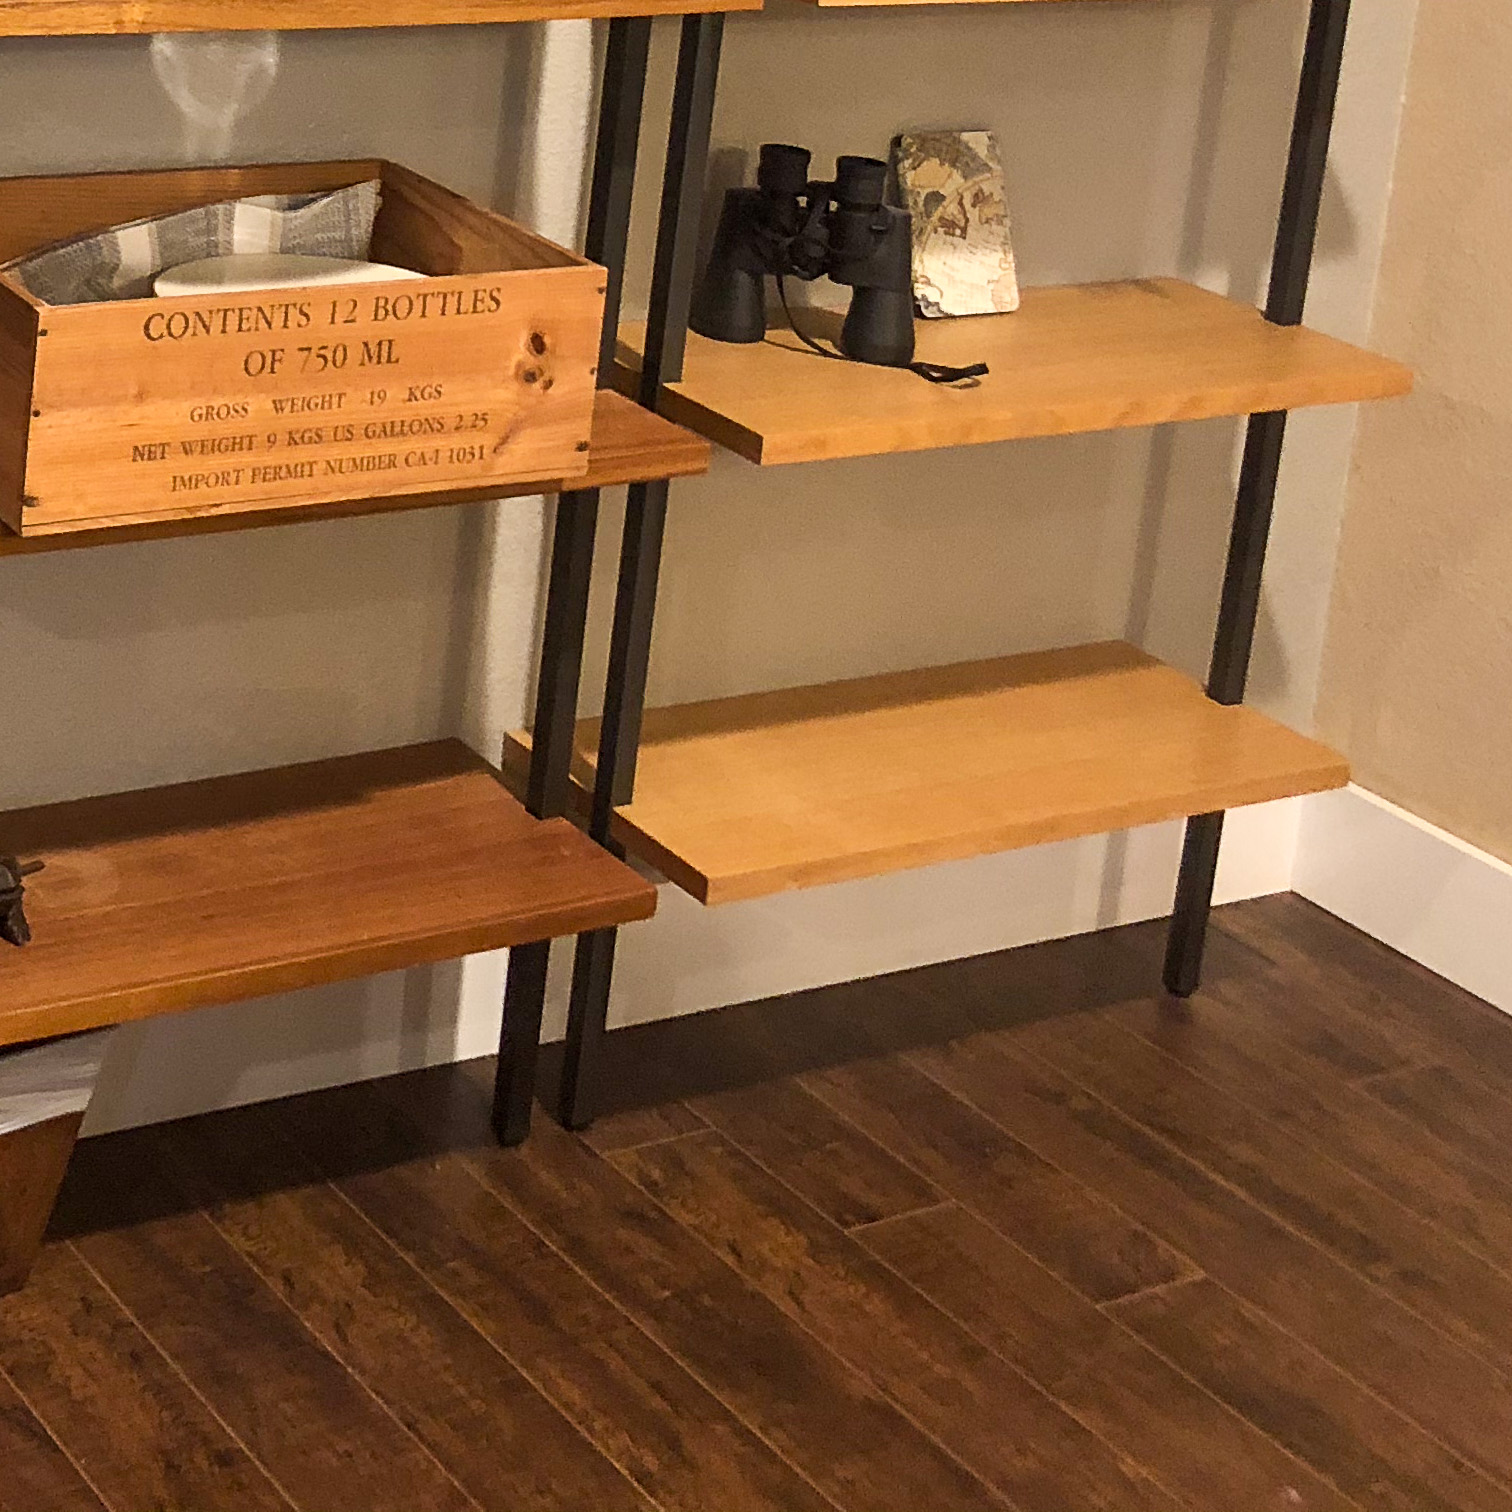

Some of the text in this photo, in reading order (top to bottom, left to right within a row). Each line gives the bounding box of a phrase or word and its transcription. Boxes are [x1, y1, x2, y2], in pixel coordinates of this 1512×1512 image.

[143, 287, 502, 342] CONTENTS 12 BOTTLES
[243, 339, 400, 377] OF 750 ML
[190, 384, 443, 424] GROSS WEIGHT 19 KGS
[132, 417, 445, 462] NET WEIGHT 9 KGS US GALLONS
[171, 444, 484, 492] IMPORT PERMIT NUMBER 1031
